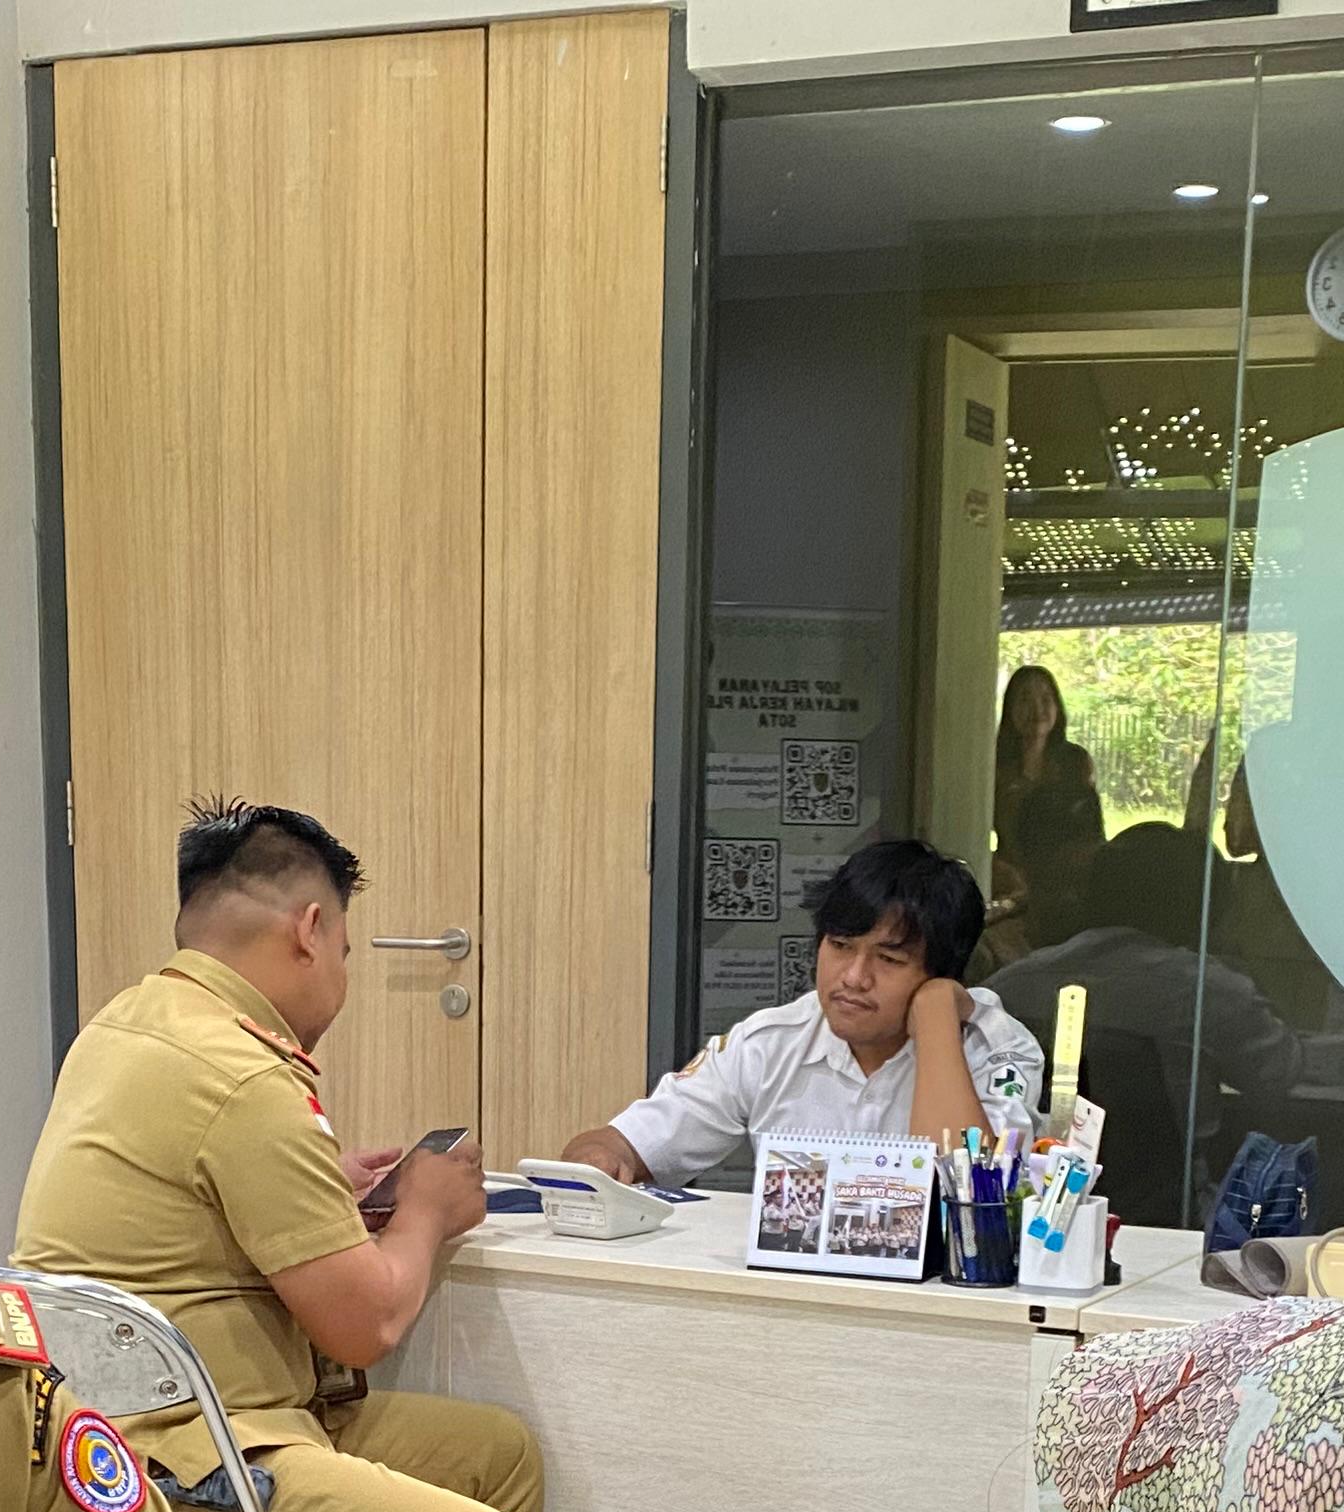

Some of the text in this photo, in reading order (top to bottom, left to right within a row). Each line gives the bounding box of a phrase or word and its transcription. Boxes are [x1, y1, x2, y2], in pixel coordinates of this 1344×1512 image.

[835, 1186, 924, 1201] SAKA BAKTI HUSADA
[1, 1291, 38, 1347] BNPP
